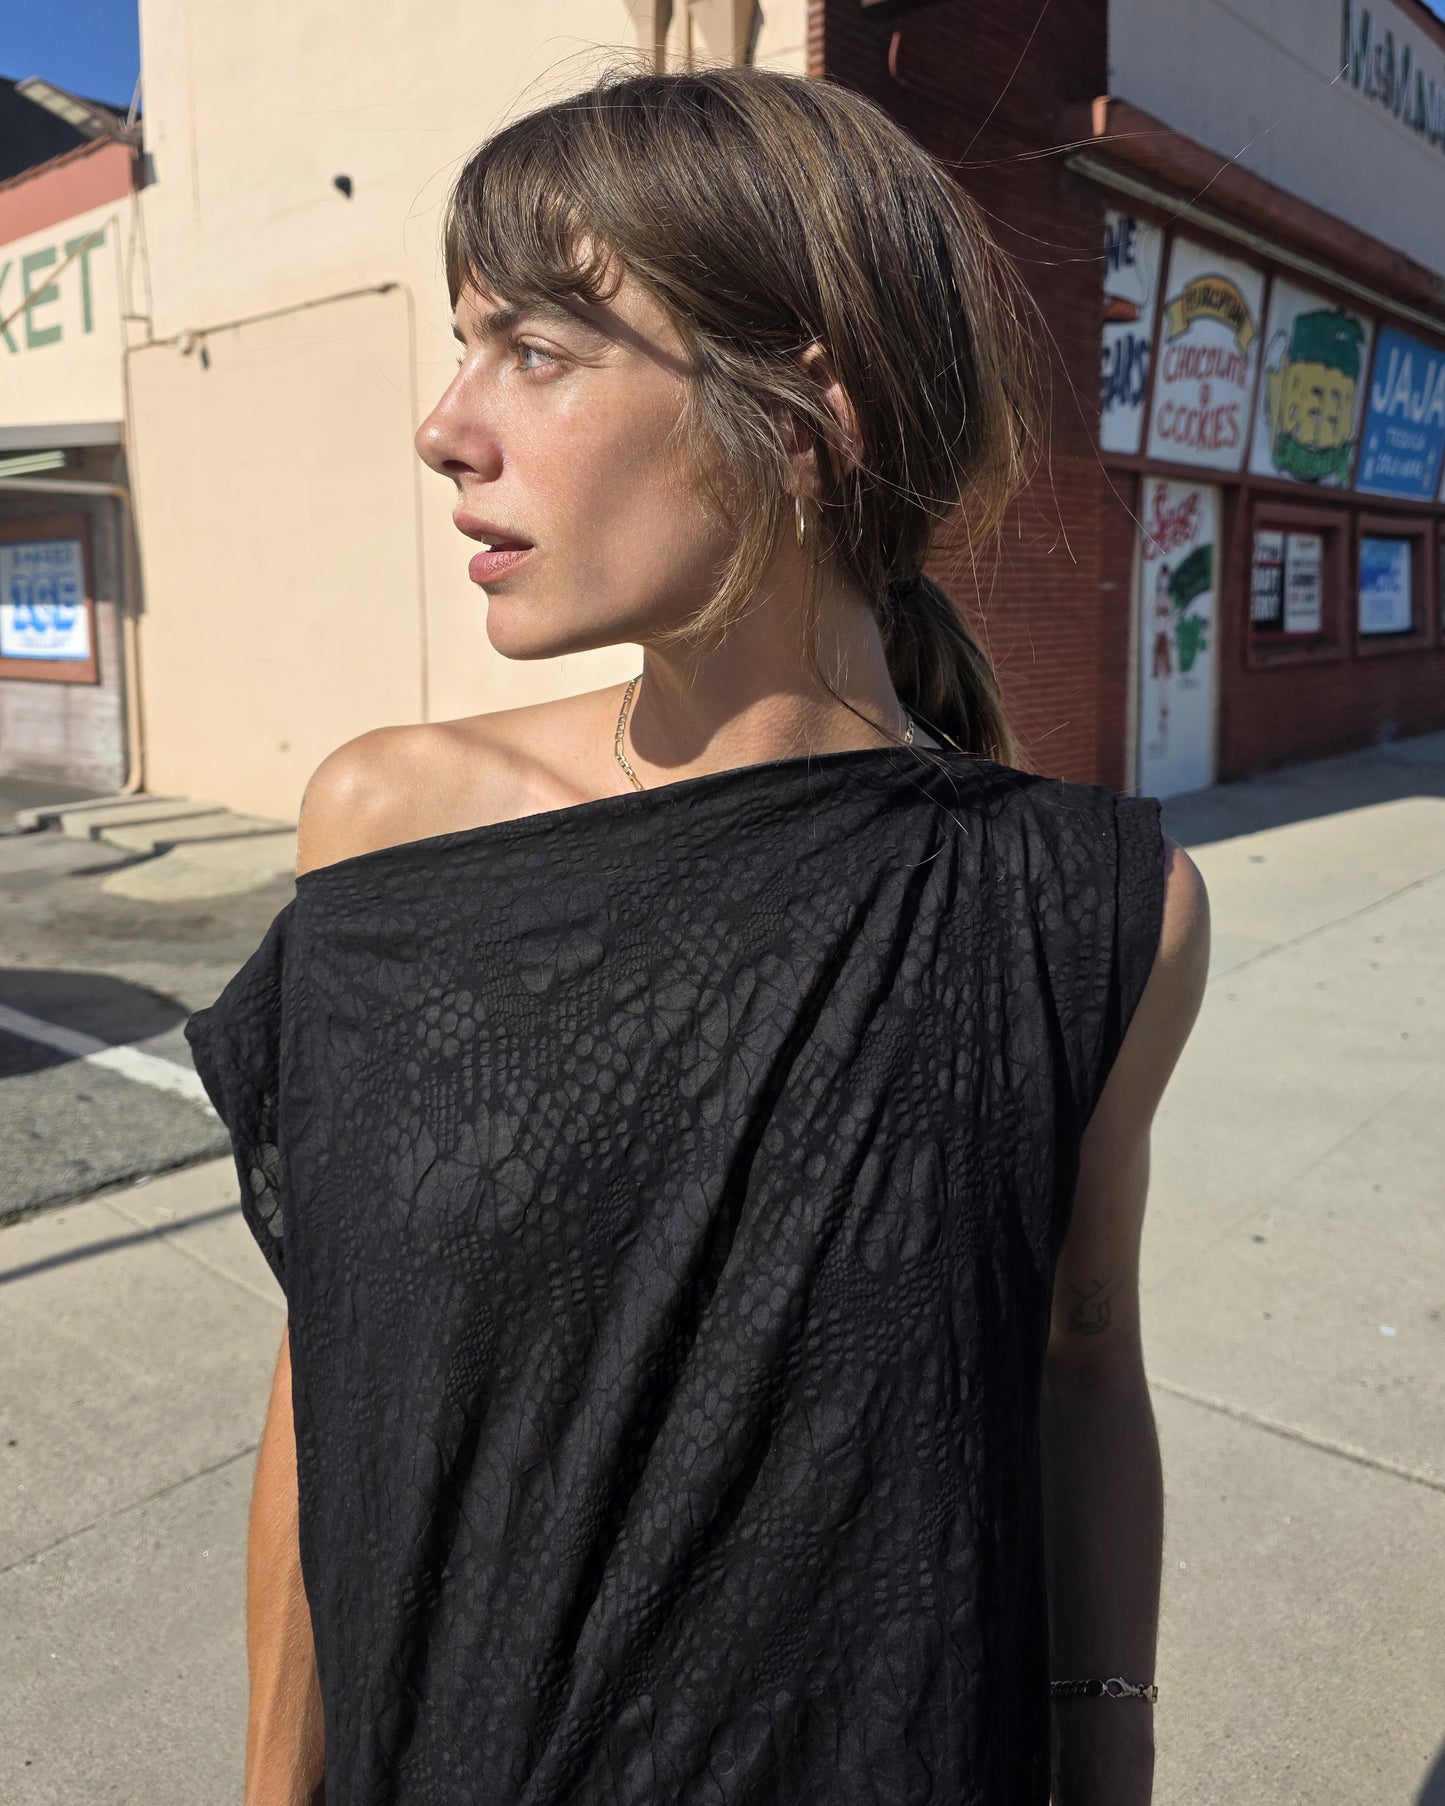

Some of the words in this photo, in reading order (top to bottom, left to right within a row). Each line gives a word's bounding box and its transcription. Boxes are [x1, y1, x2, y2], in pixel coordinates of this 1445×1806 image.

[1162, 345, 1248, 391] CHOCOLATE
[1372, 346, 1445, 427] JAJA
[1156, 403, 1241, 452] COOKIES
[1282, 361, 1357, 449] BEER
[11, 572, 77, 632] ICE
